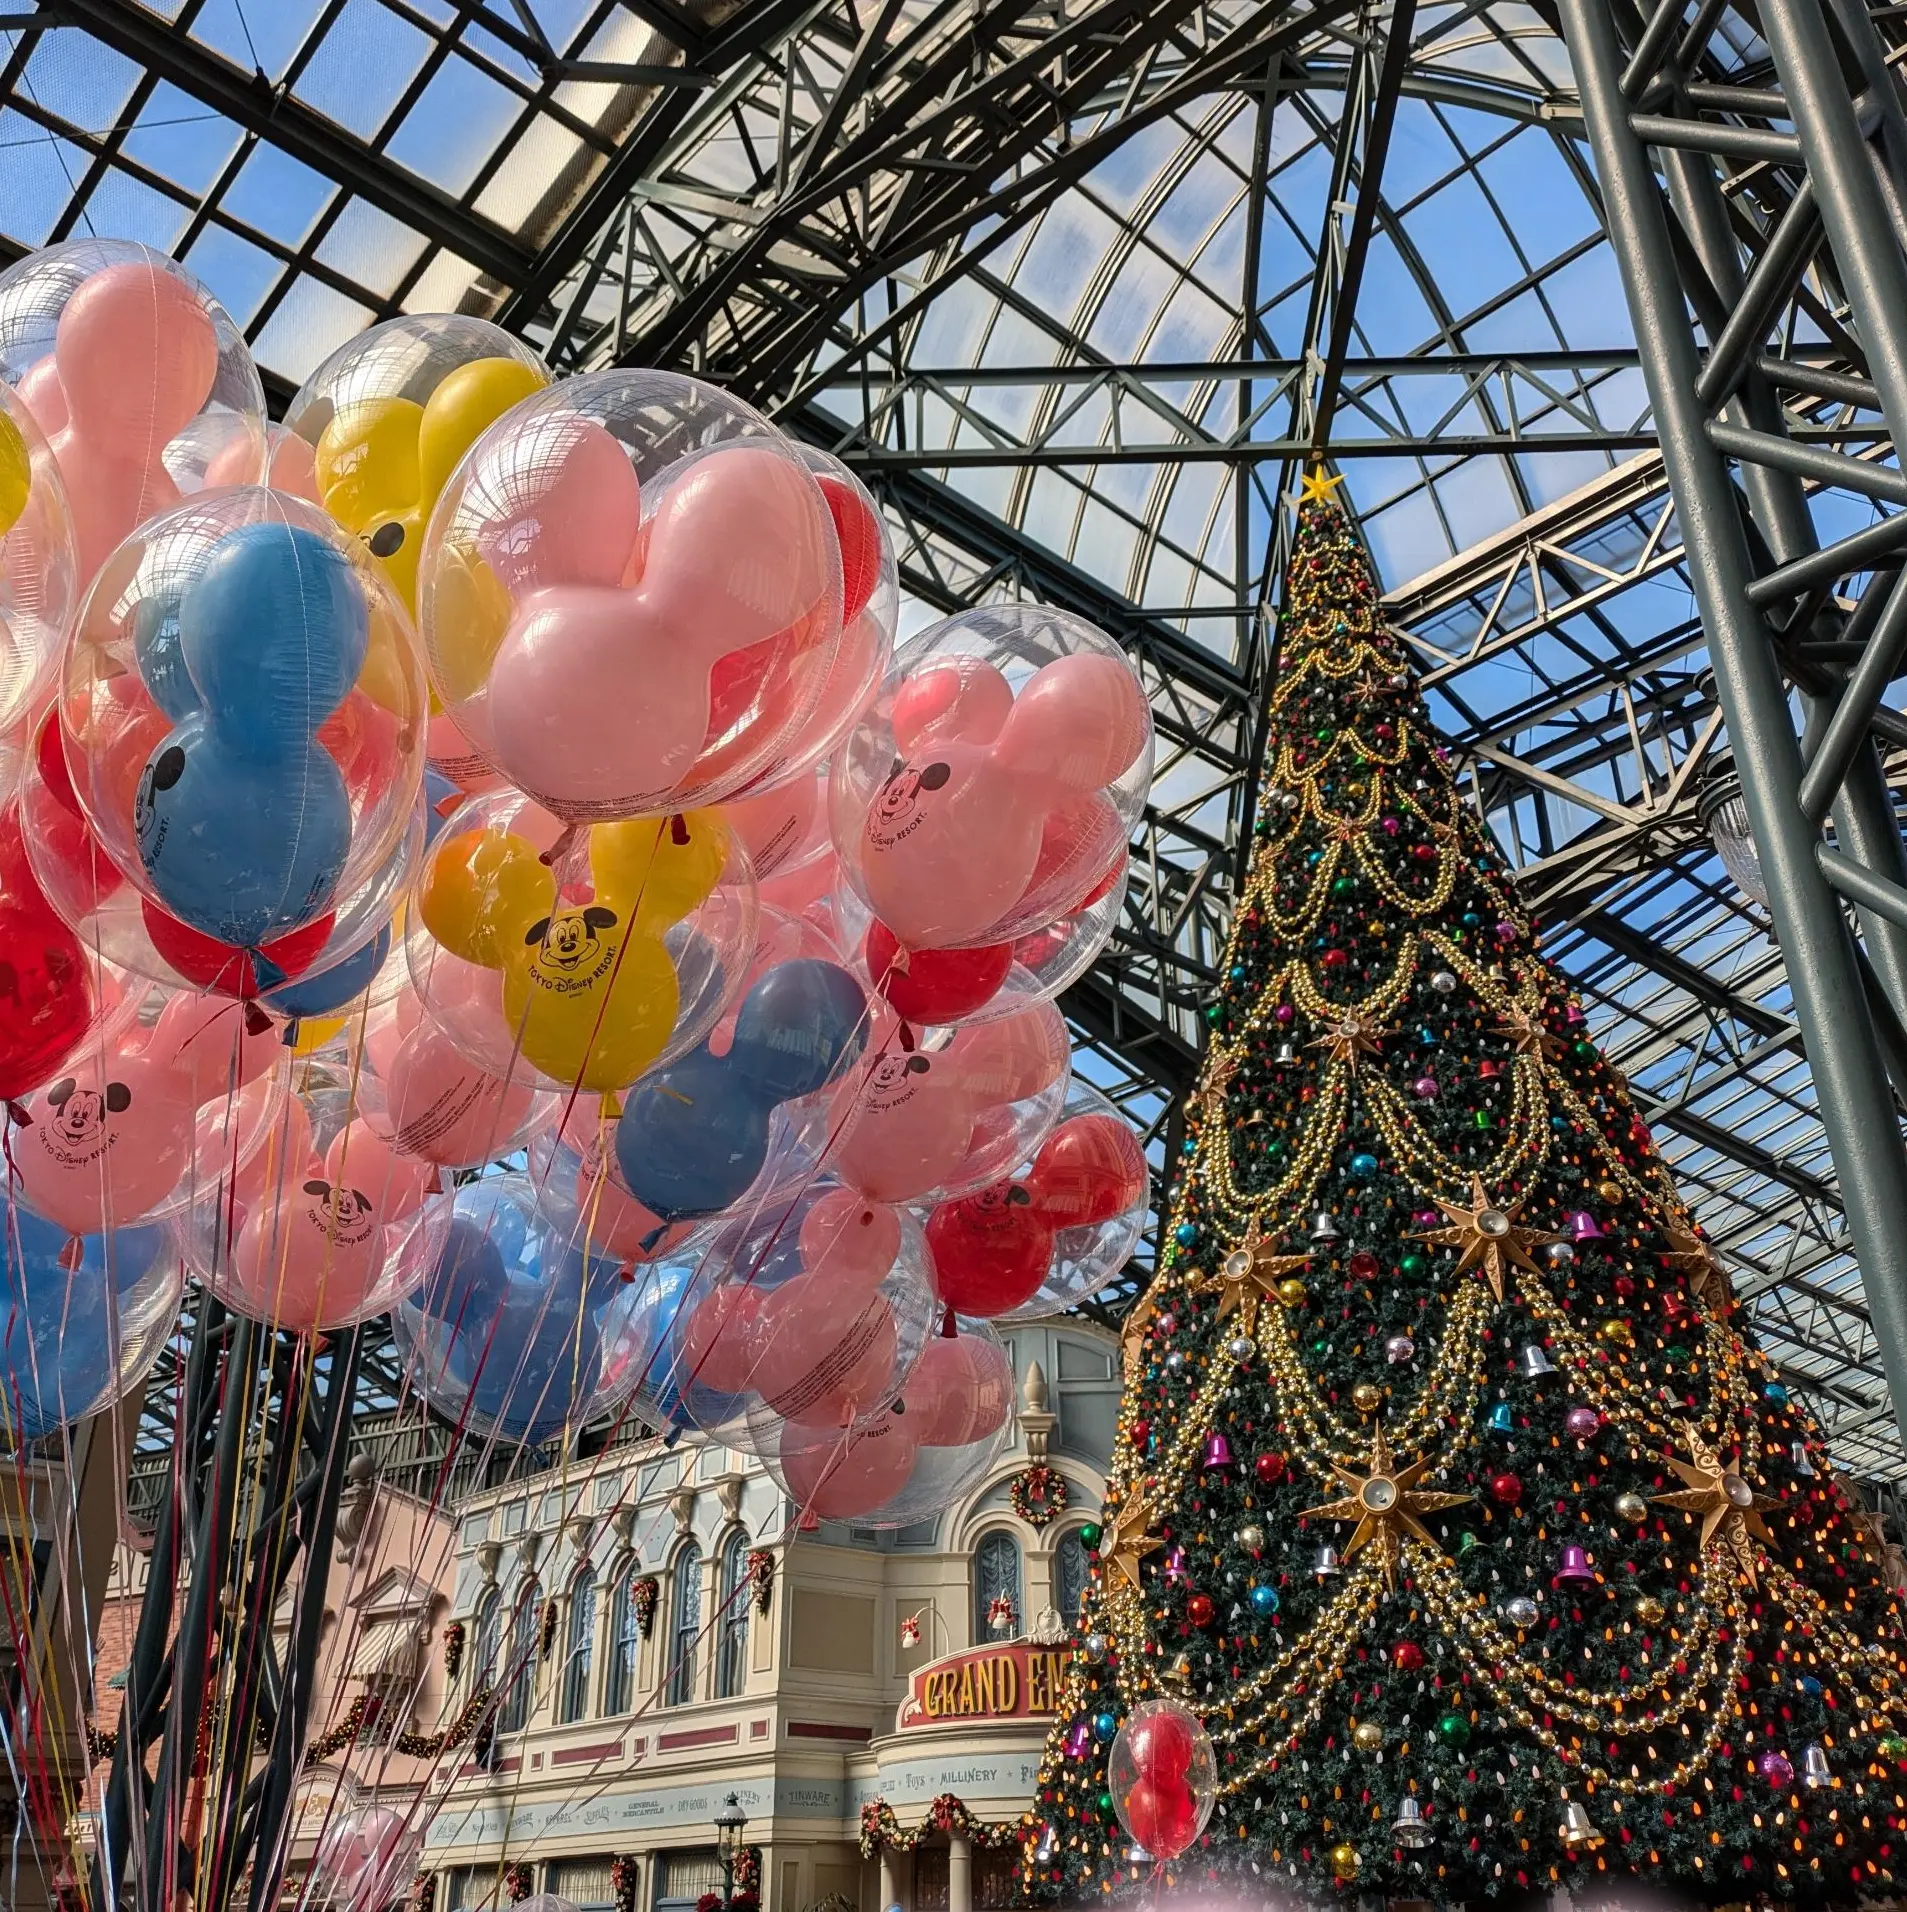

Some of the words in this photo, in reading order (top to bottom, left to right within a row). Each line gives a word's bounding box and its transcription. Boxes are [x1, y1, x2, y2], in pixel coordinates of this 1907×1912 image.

[896, 812, 925, 840] RESORT
[528, 963, 553, 990] TOKYO
[593, 946, 617, 978] RESORT
[40, 1126, 54, 1154] TOKYO
[307, 1209, 327, 1232] TOKYO
[924, 1655, 1018, 1717] GRAND
[906, 1773, 925, 1790] Toys
[940, 1767, 998, 1786] MILLINERY
[628, 1800, 660, 1810] GENERAL
[789, 1790, 831, 1803] TINWARE
[622, 1807, 665, 1818] MERCANTILE
